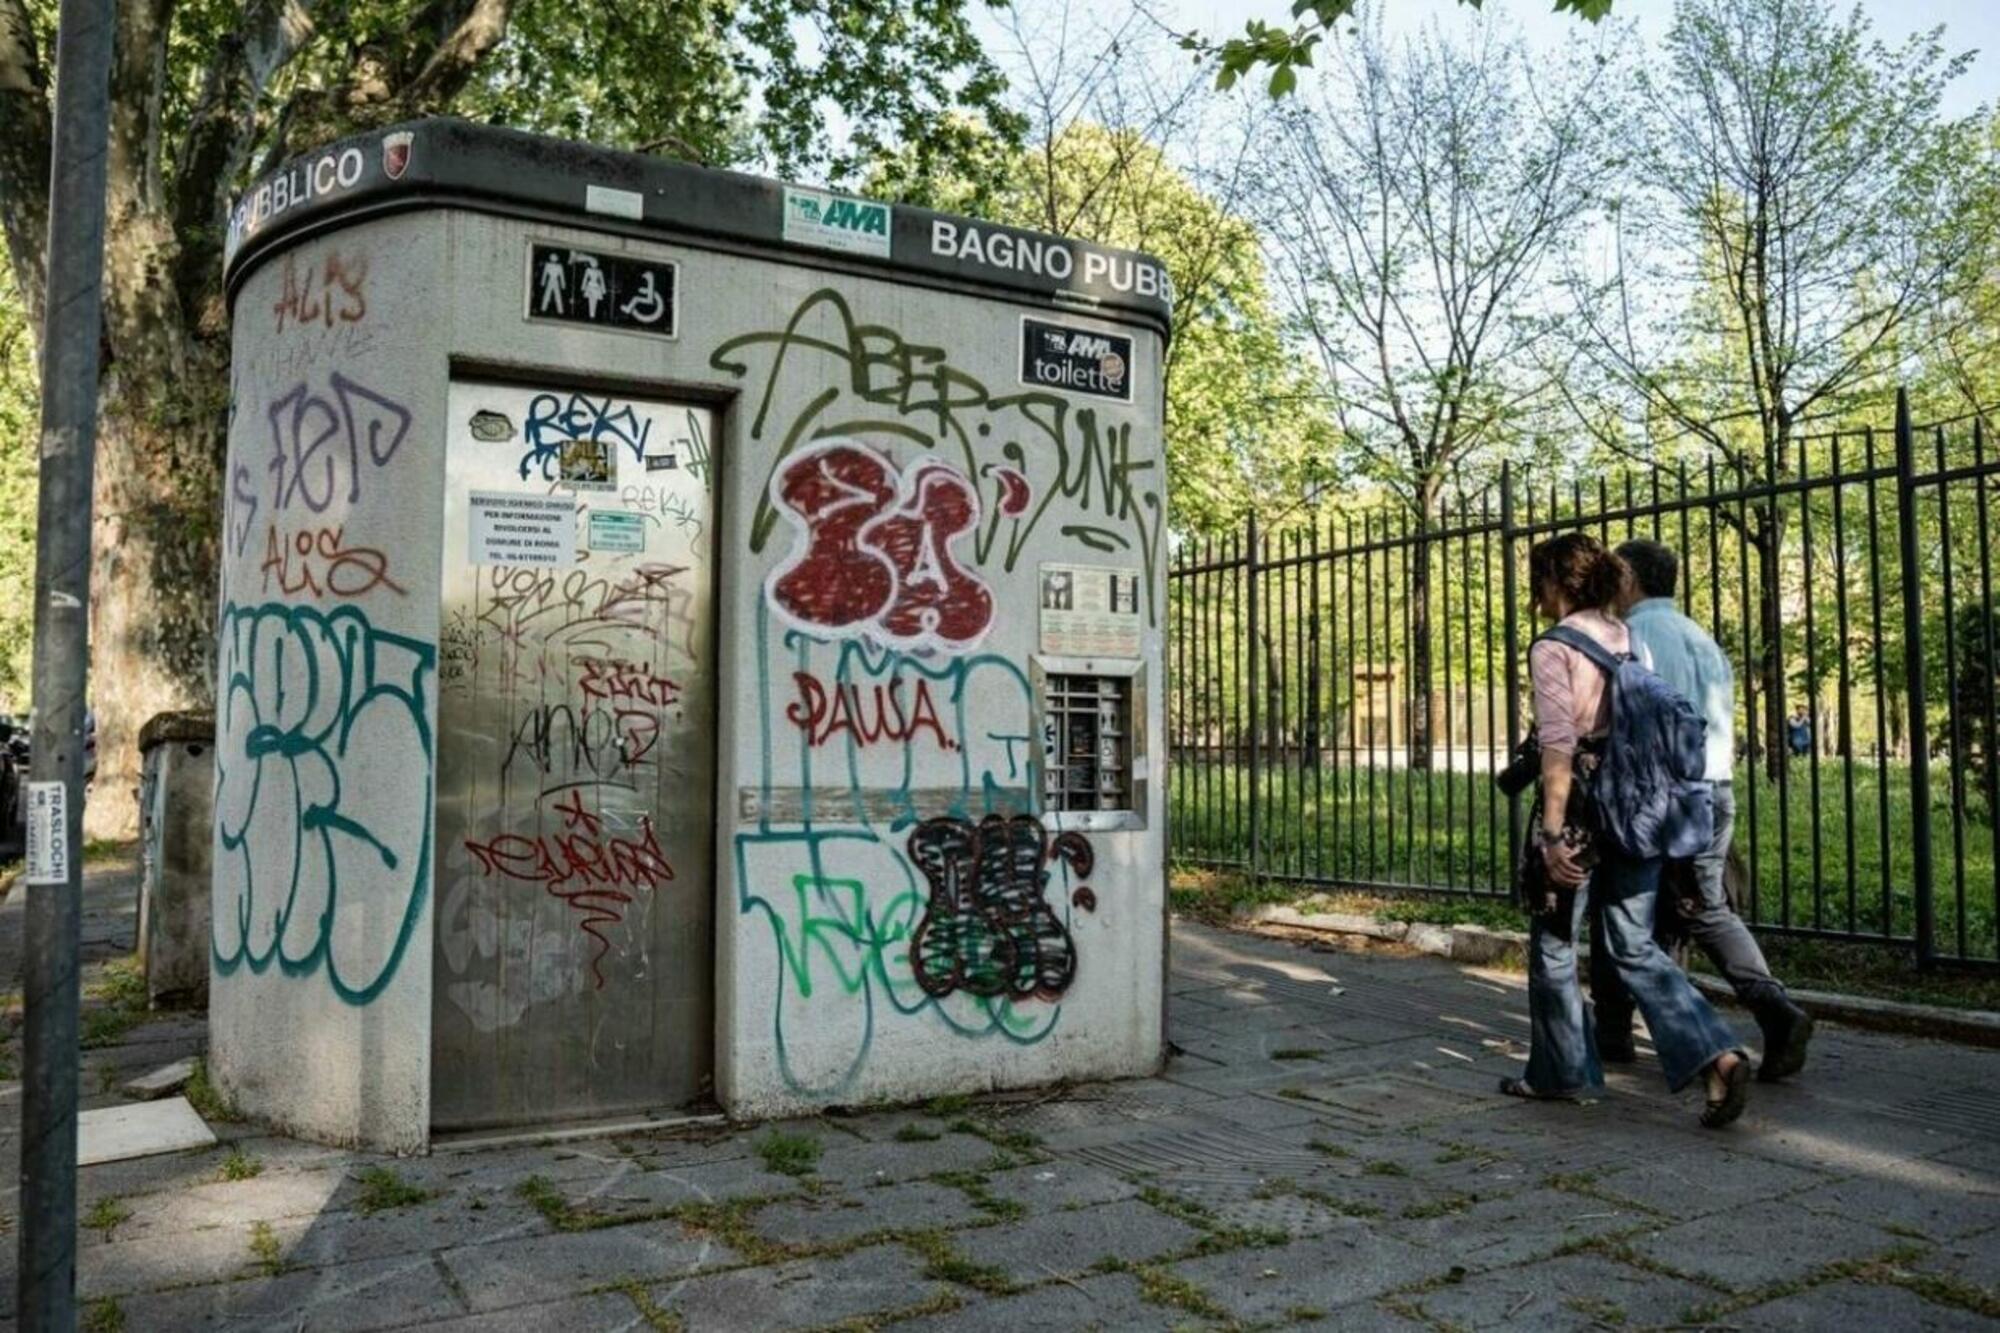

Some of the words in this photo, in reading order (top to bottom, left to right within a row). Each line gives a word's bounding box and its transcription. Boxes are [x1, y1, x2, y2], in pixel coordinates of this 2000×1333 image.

[822, 199, 887, 236] AMA
[931, 219, 1073, 279] BAGNO
[1035, 357, 1122, 393] toilette
[50, 786, 64, 879] TRASLOCHI
